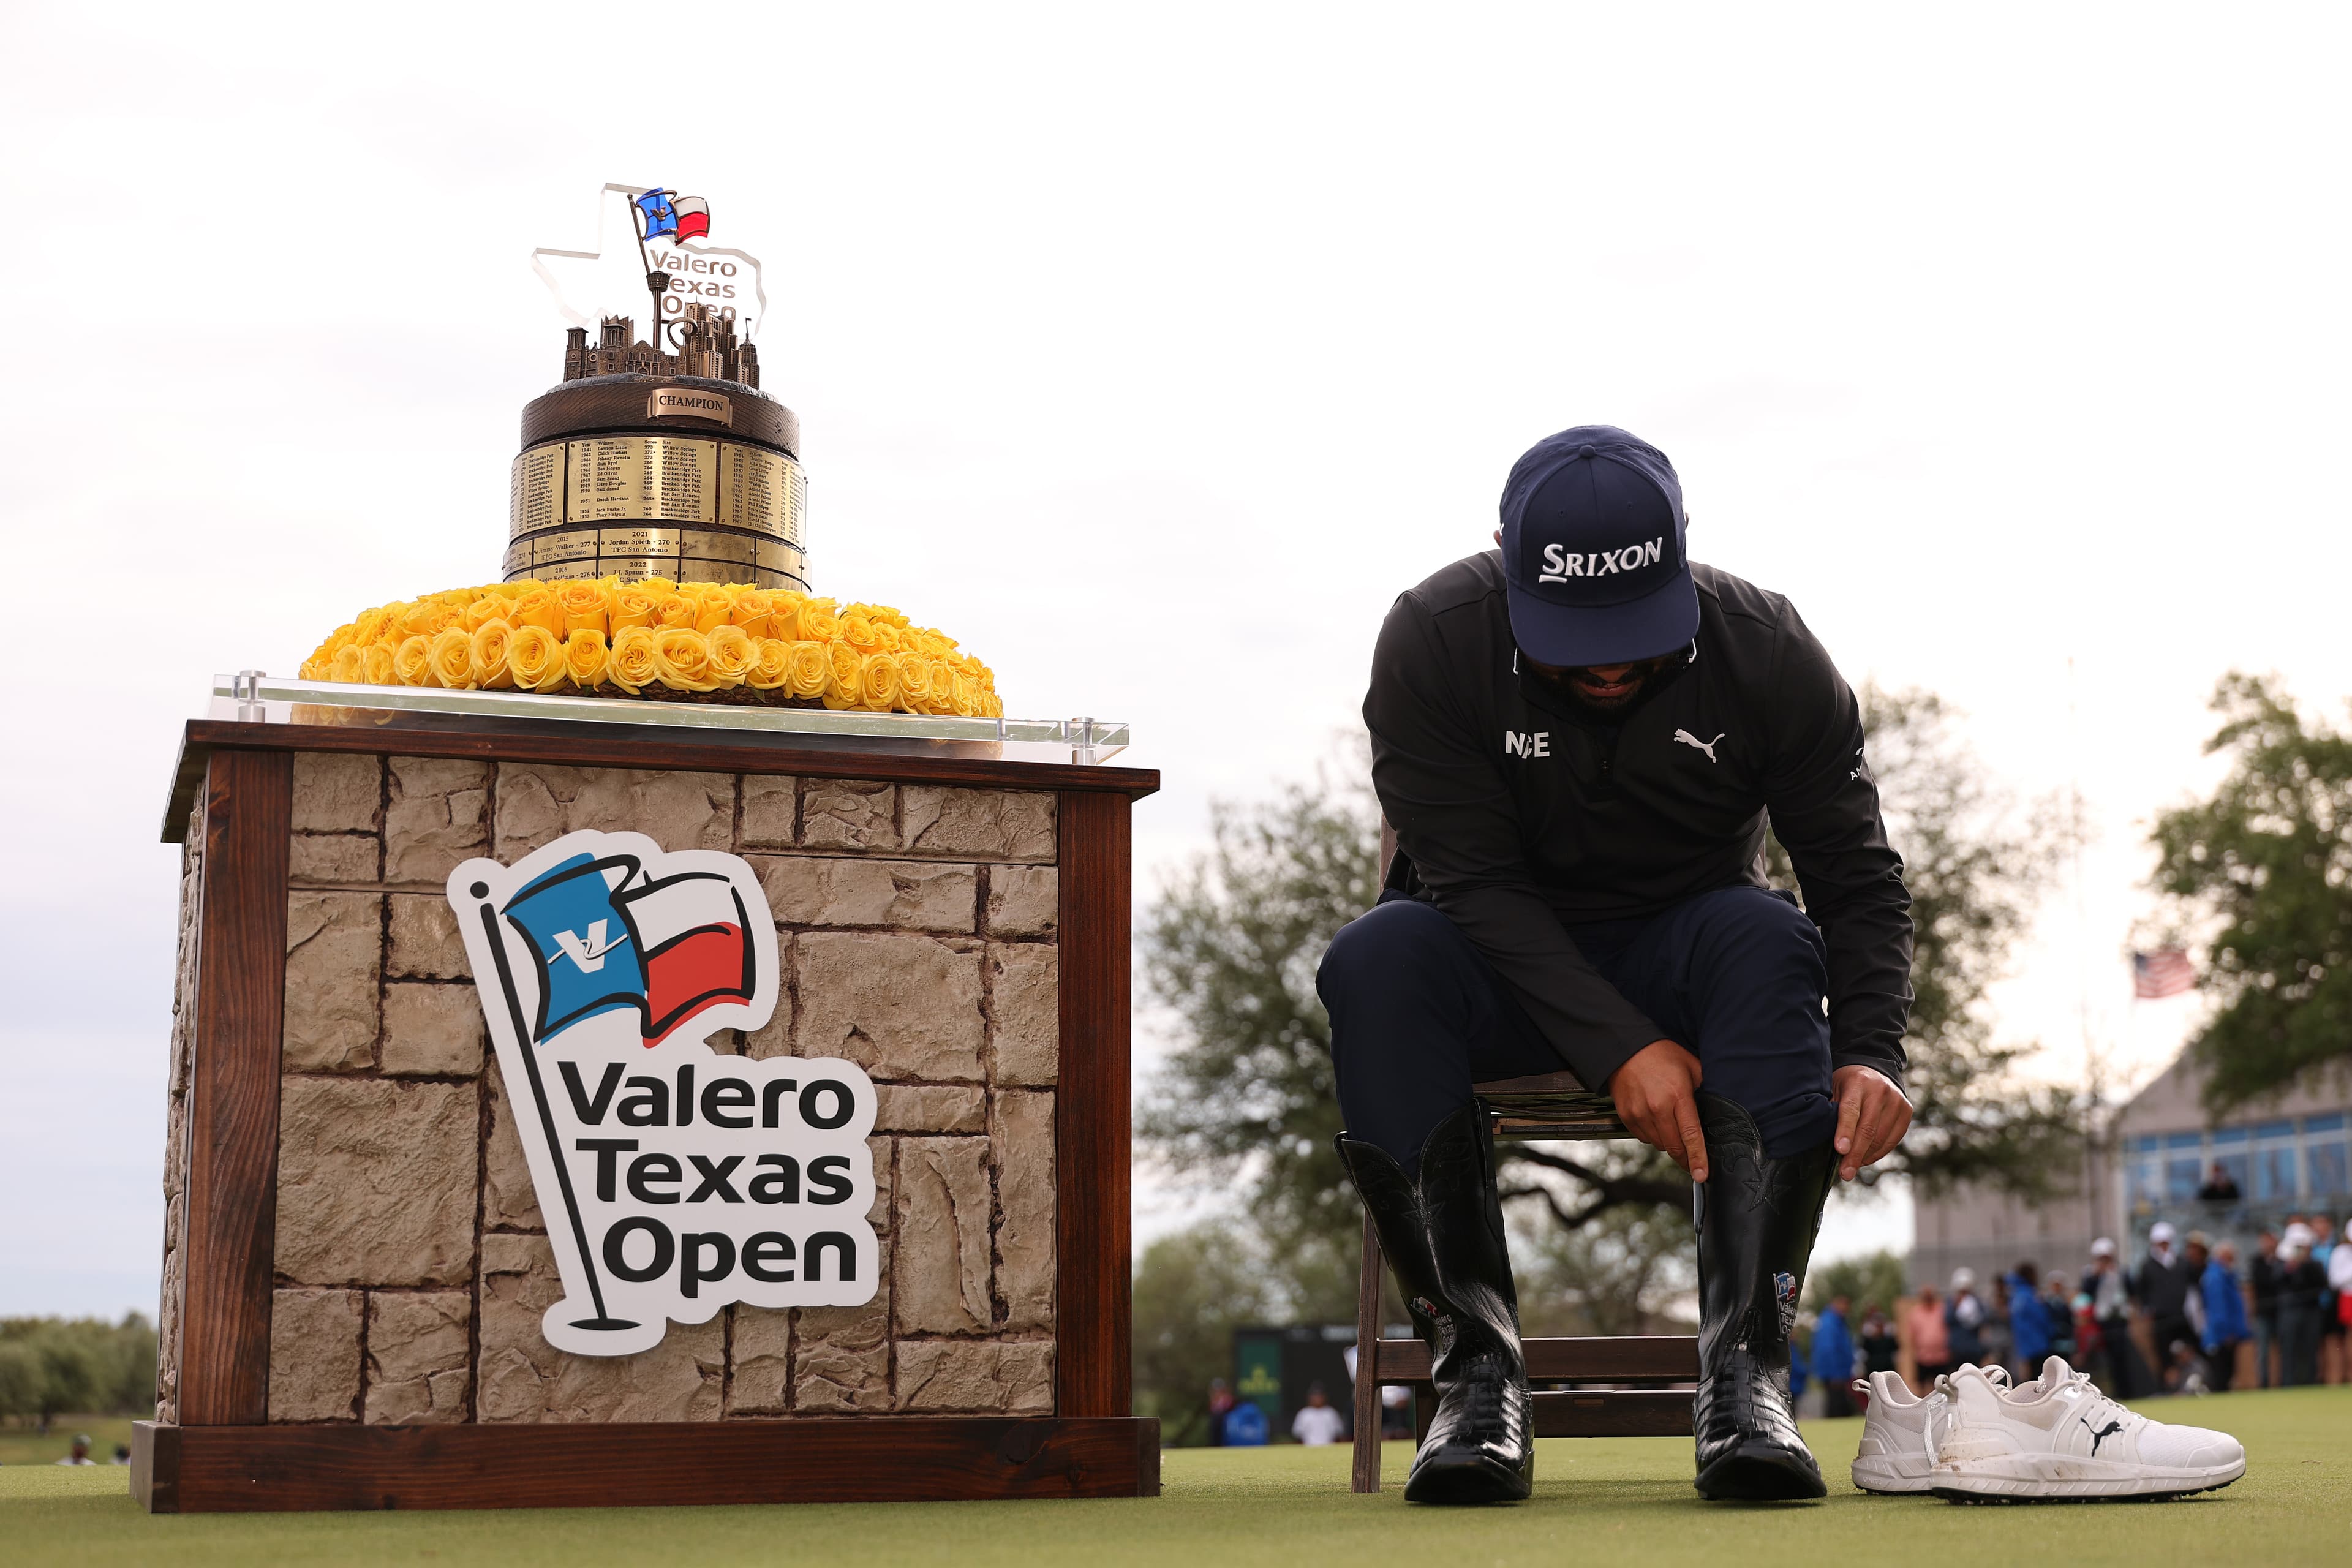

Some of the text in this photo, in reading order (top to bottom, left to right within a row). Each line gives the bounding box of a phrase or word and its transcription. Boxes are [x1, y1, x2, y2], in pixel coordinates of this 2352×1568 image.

[650, 250, 736, 277] Valero
[666, 273, 735, 298] exas
[662, 296, 736, 320] Oen
[659, 396, 723, 411] CHAMPION
[1541, 537, 1662, 577] SRIXON
[557, 1061, 855, 1129] Valero
[576, 1139, 853, 1204] Texas
[603, 1216, 857, 1298] Open
